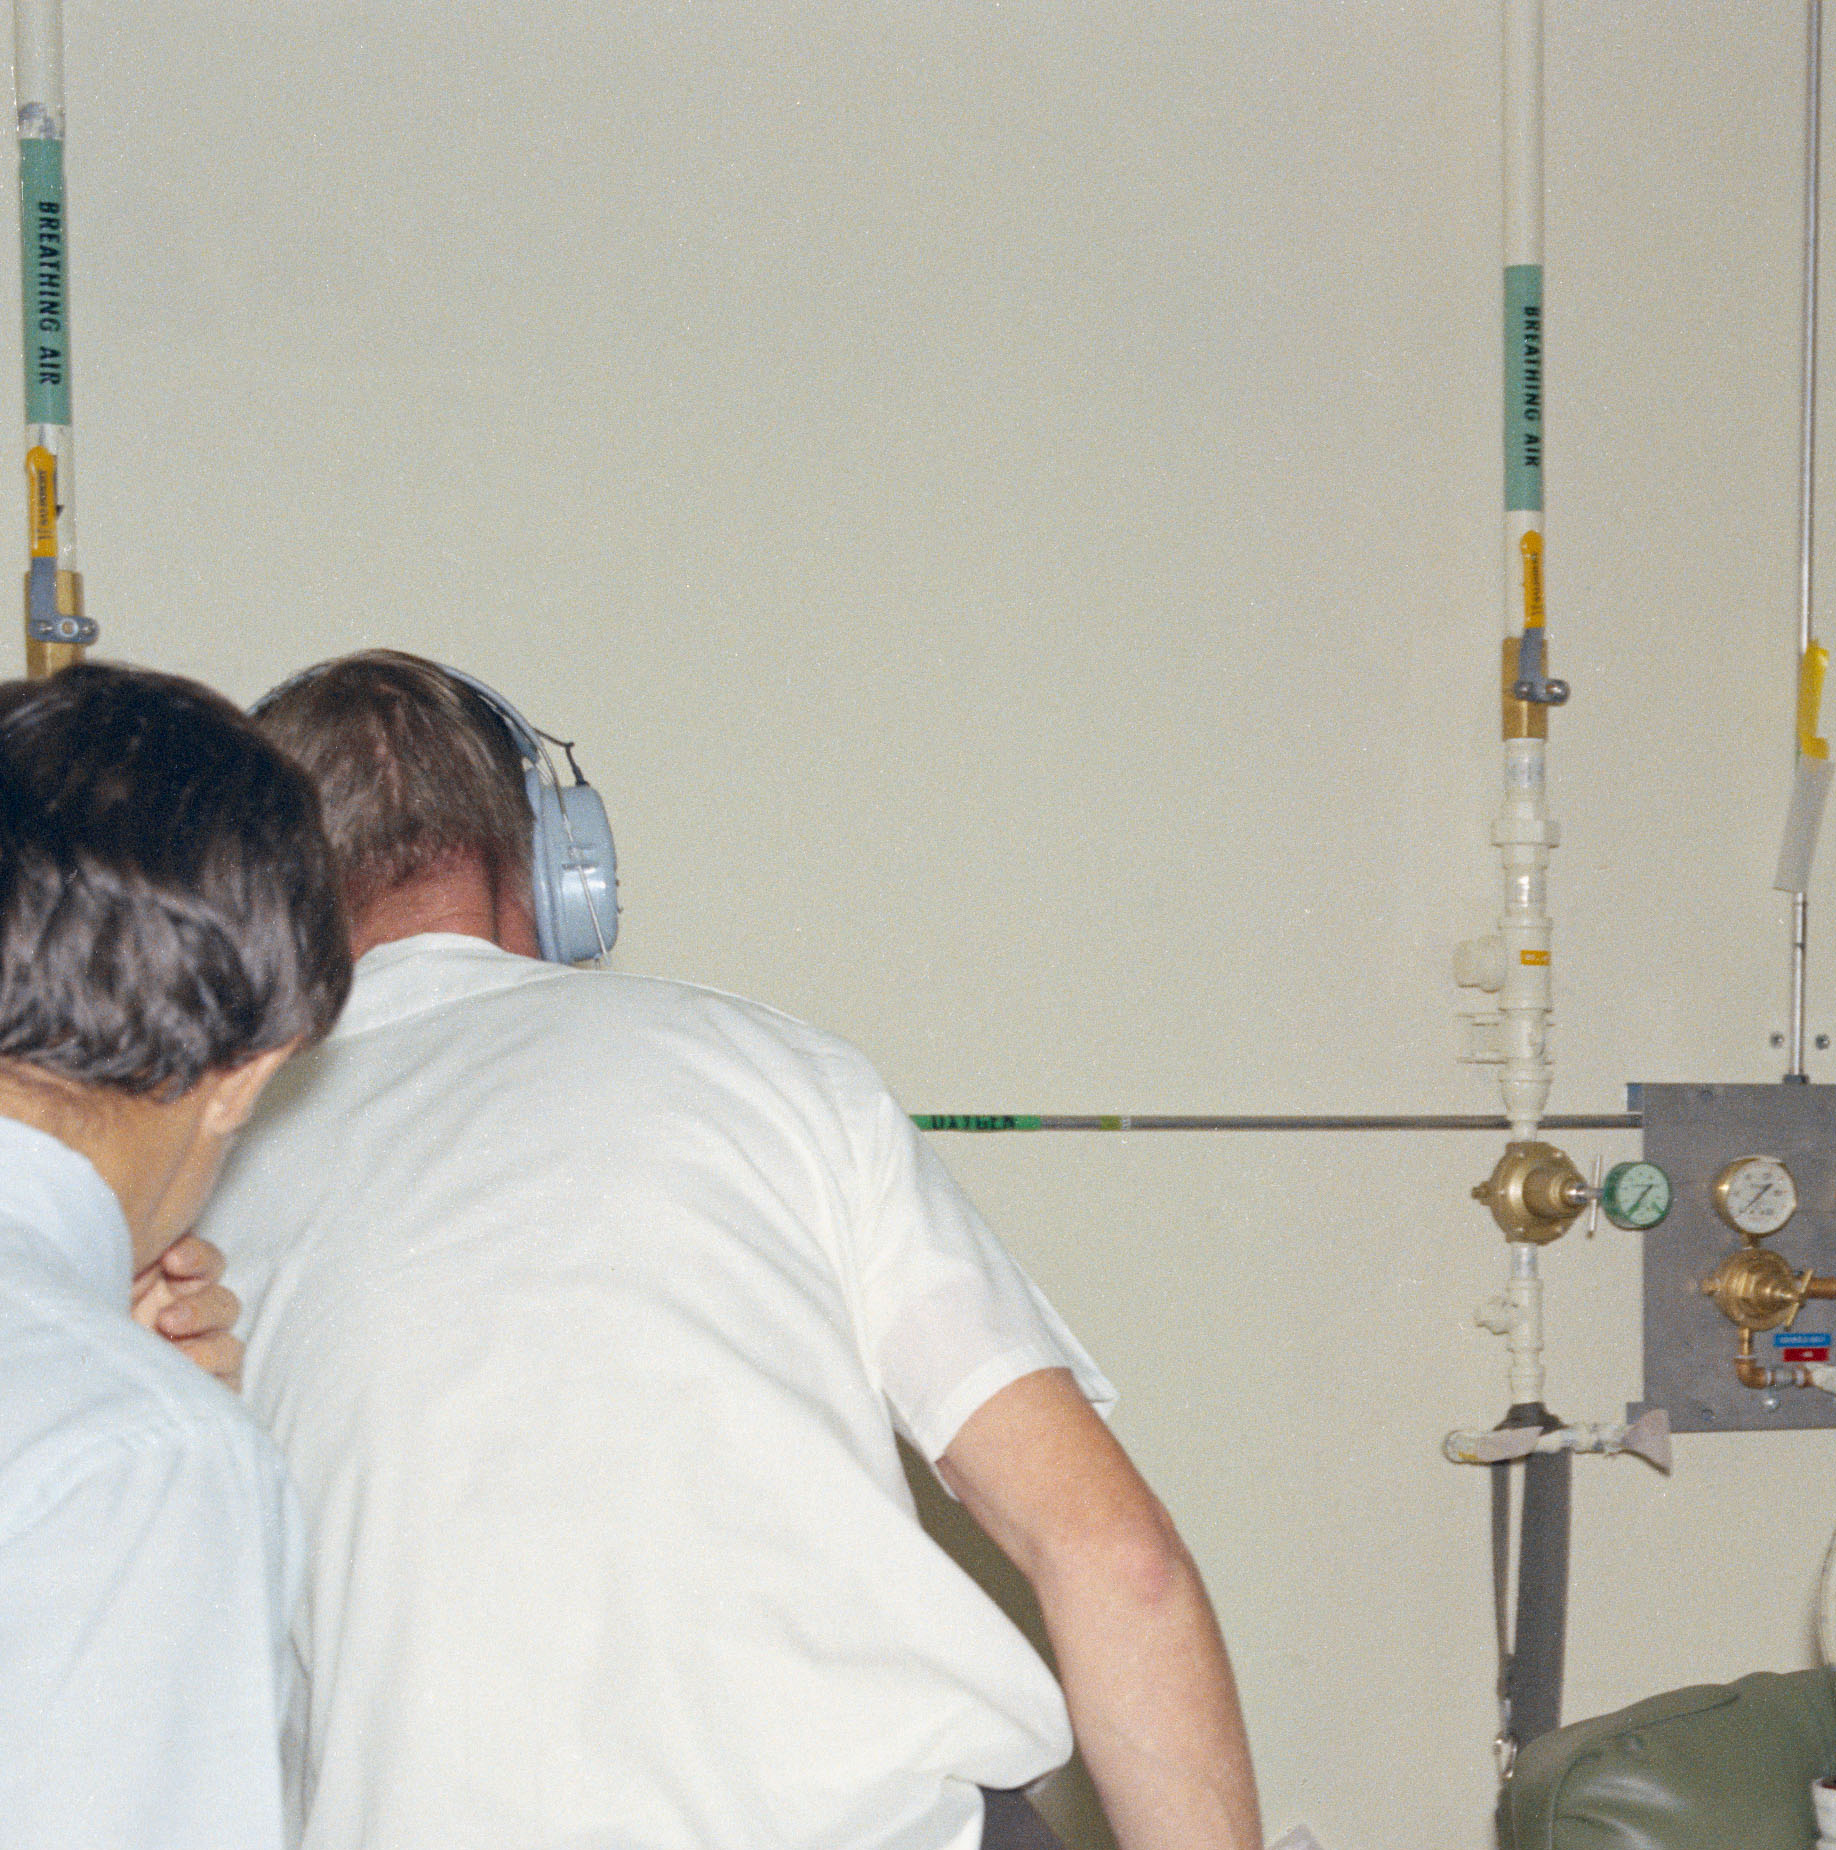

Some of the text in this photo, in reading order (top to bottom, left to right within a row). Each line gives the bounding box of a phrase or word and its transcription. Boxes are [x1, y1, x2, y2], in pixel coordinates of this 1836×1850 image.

[38, 201, 61, 386] BREATHING AIR
[1524, 306, 1542, 467] BREATHING AIR
